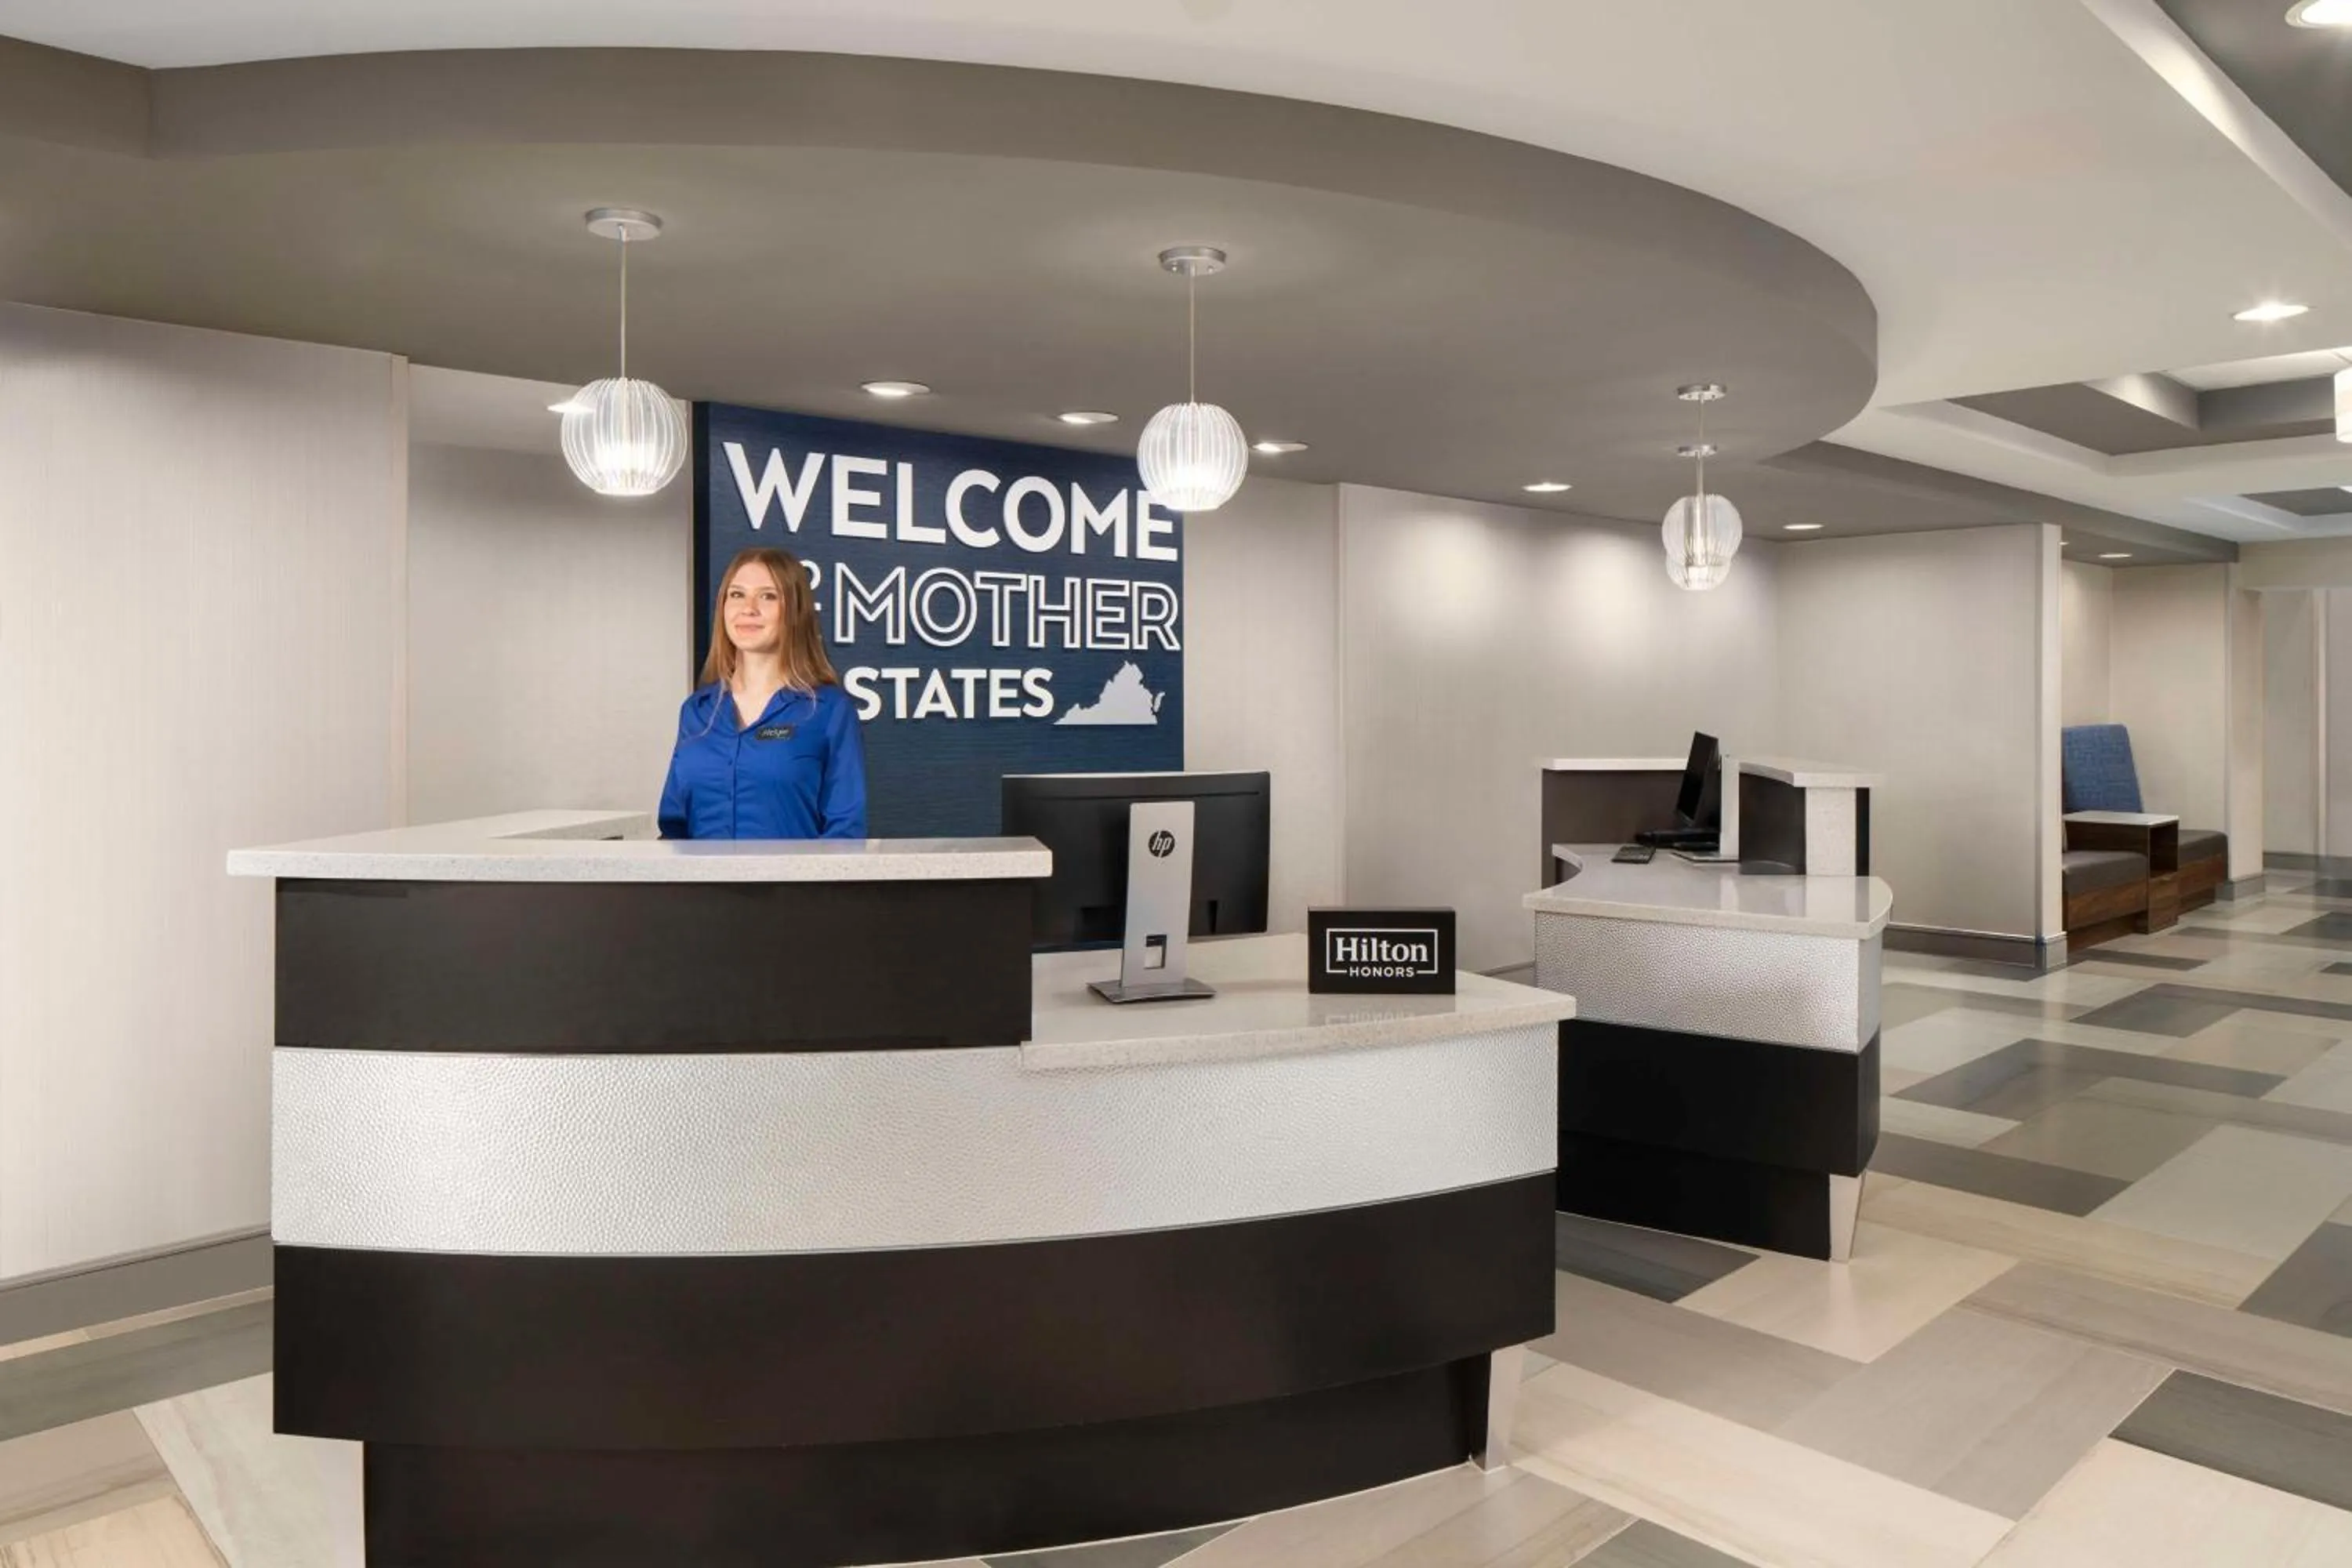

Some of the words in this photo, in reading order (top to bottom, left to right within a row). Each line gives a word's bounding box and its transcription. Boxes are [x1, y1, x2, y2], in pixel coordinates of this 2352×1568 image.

[722, 441, 1178, 561] WELCOME
[833, 561, 1181, 652] MOTHER
[844, 666, 1054, 720] STATES
[1150, 830, 1174, 858] hp
[1335, 937, 1428, 962] Hilton
[1349, 966, 1414, 978] HONORS
